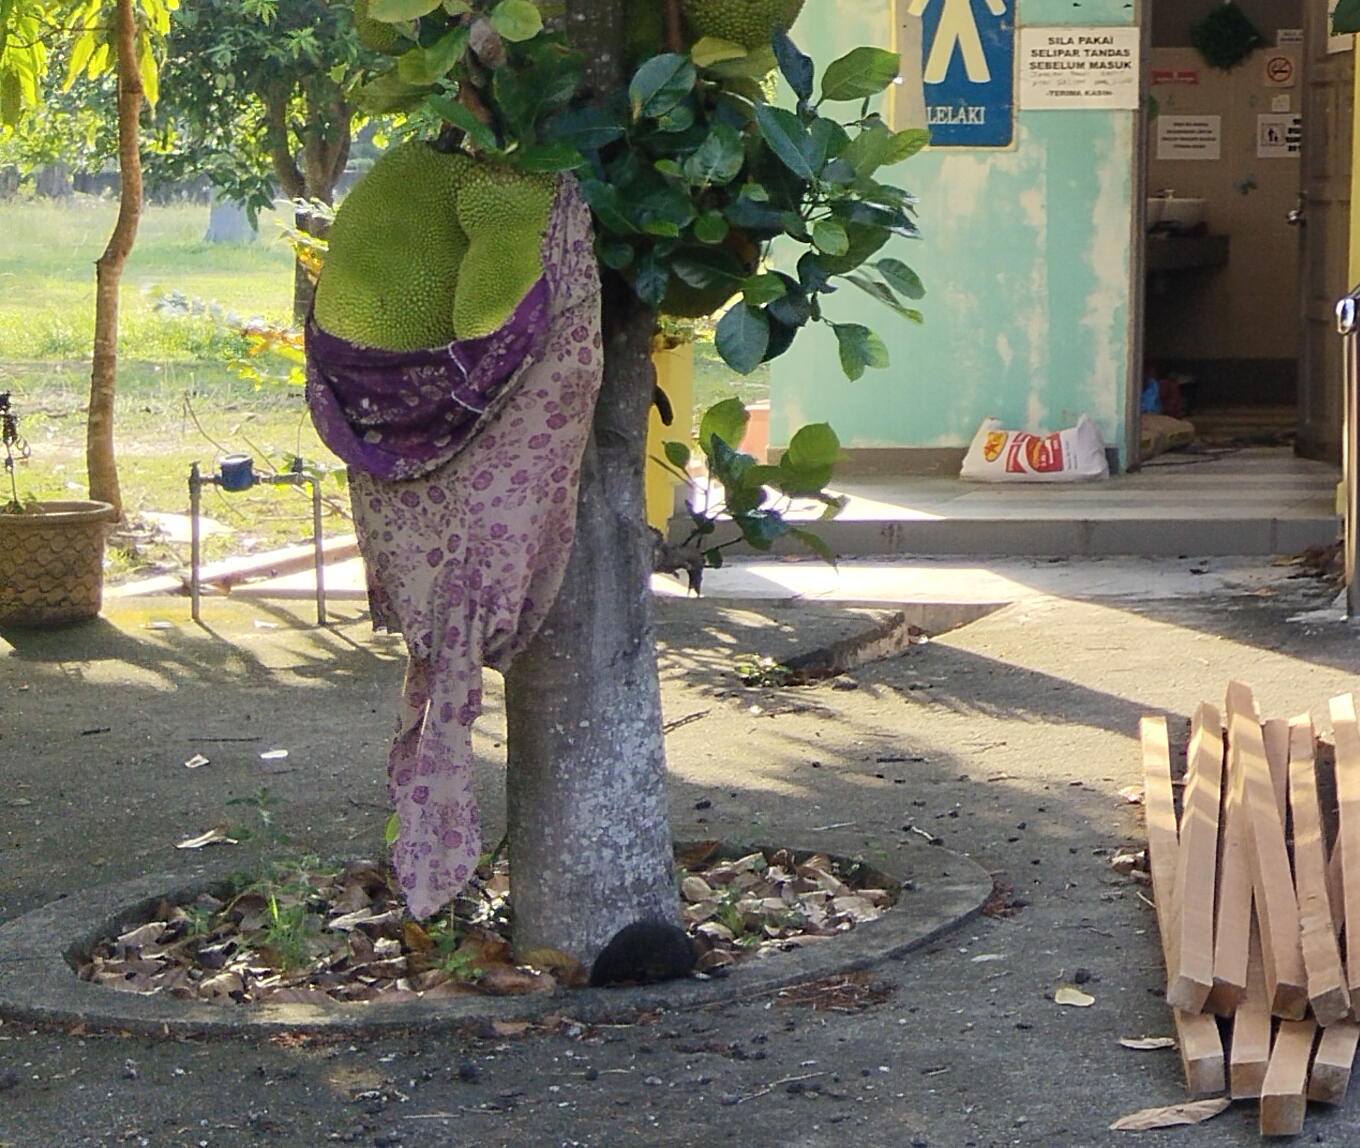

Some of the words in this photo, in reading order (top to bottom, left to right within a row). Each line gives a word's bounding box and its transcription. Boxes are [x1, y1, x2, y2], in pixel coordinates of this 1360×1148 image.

[1048, 36, 1075, 46] SILA
[1078, 36, 1115, 45] PAKAI
[1030, 48, 1081, 58] SELIPAR
[1083, 48, 1132, 58] TANDAS
[1029, 61, 1086, 70] SEBELUM
[1089, 60, 1133, 70] MASUK
[926, 105, 986, 125] LELAKI
